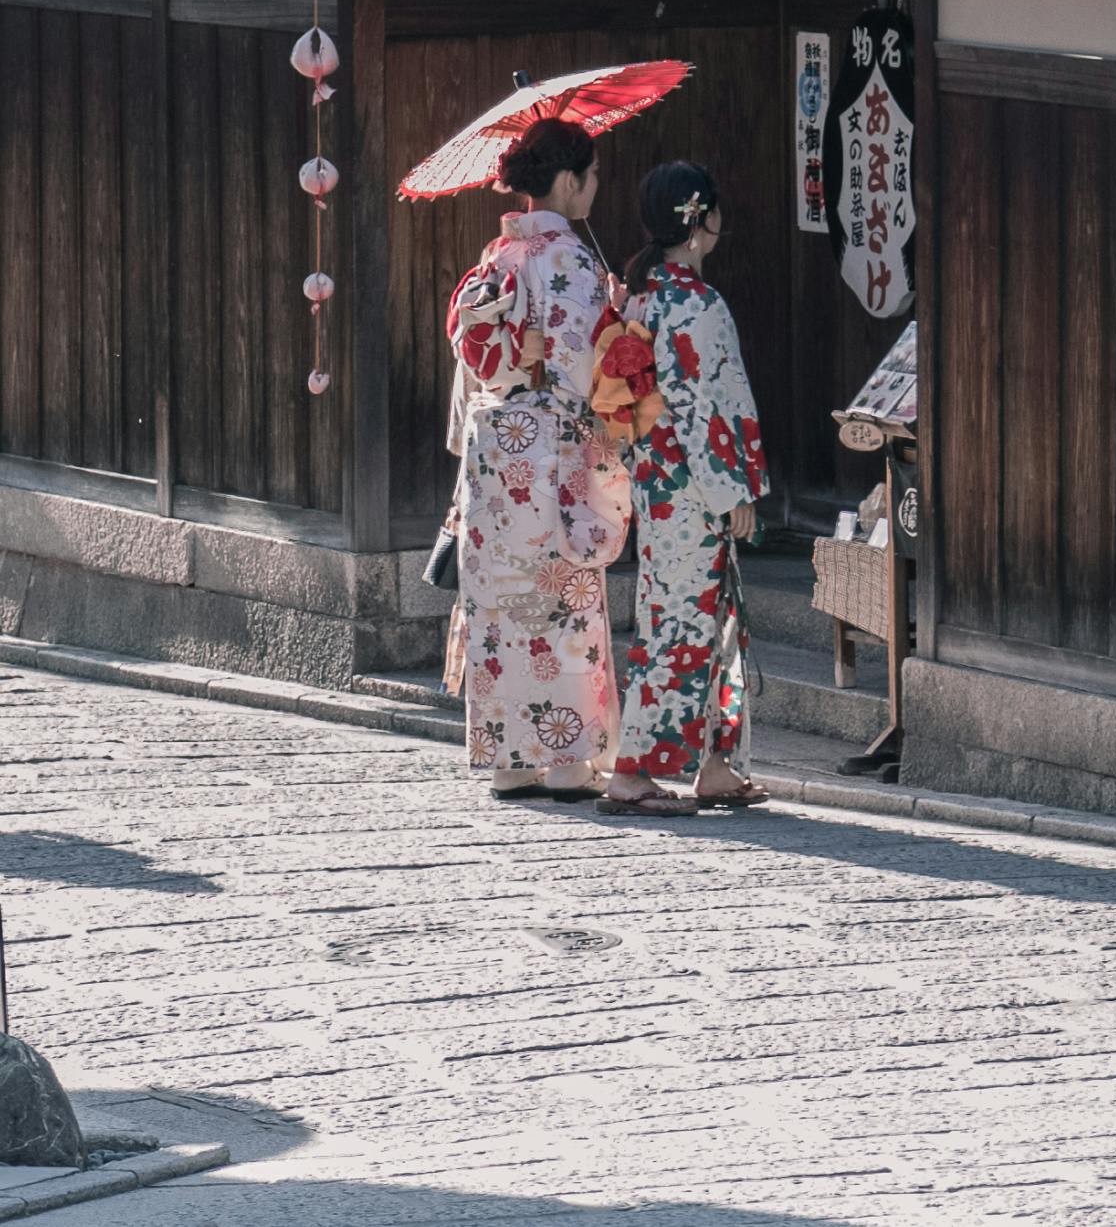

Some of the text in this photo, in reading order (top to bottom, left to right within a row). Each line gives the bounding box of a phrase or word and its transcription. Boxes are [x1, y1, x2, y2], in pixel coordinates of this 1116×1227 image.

[848, 107, 865, 248] 文の助茶屋
[866, 84, 892, 312] あまざけ
